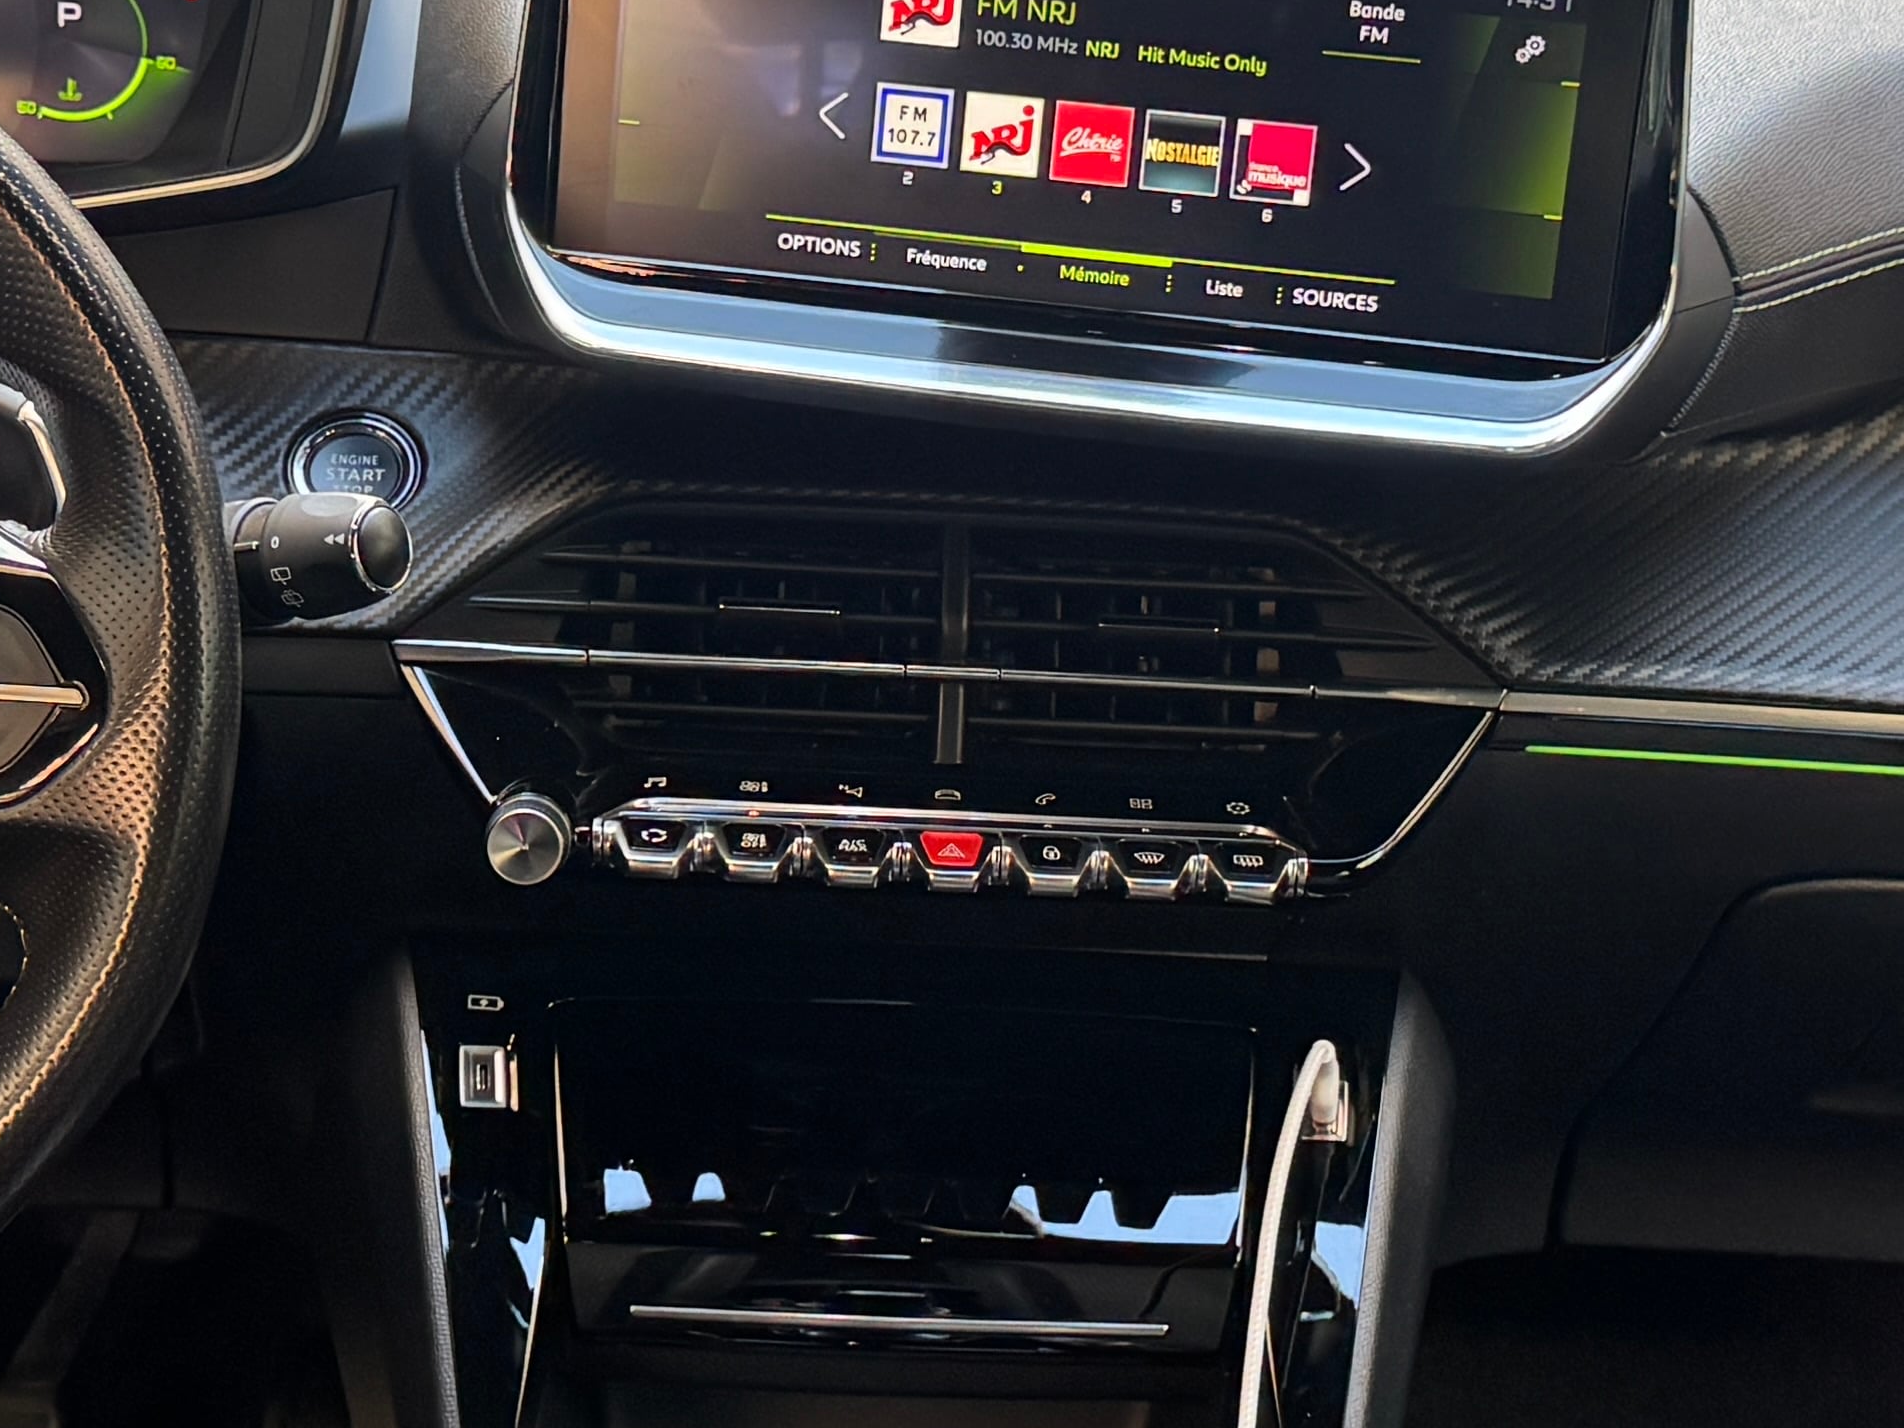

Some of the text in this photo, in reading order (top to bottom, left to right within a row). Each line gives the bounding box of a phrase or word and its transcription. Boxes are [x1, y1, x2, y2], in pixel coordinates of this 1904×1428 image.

[57, 1, 83, 28] P
[1349, 0, 1406, 23] Bande
[1359, 25, 1390, 45] FM
[976, 28, 1268, 77] 100.30 MHz NRJ Hit Music Only
[898, 105, 928, 124] FM
[887, 127, 937, 149] 107.7
[901, 172, 913, 186] 2
[991, 181, 1003, 195] 3
[1248, 171, 1307, 188] musique
[1081, 190, 1092, 204] 4
[1171, 199, 1182, 214] 5
[1261, 209, 1273, 223] 6
[777, 233, 861, 258] OPTIONS
[906, 247, 987, 273] Fréquence
[1059, 263, 1130, 287] Mémoire
[1205, 279, 1244, 299] Liste
[1292, 288, 1379, 314] SOURCES
[330, 453, 379, 466] ENGINE
[325, 467, 386, 482] START
